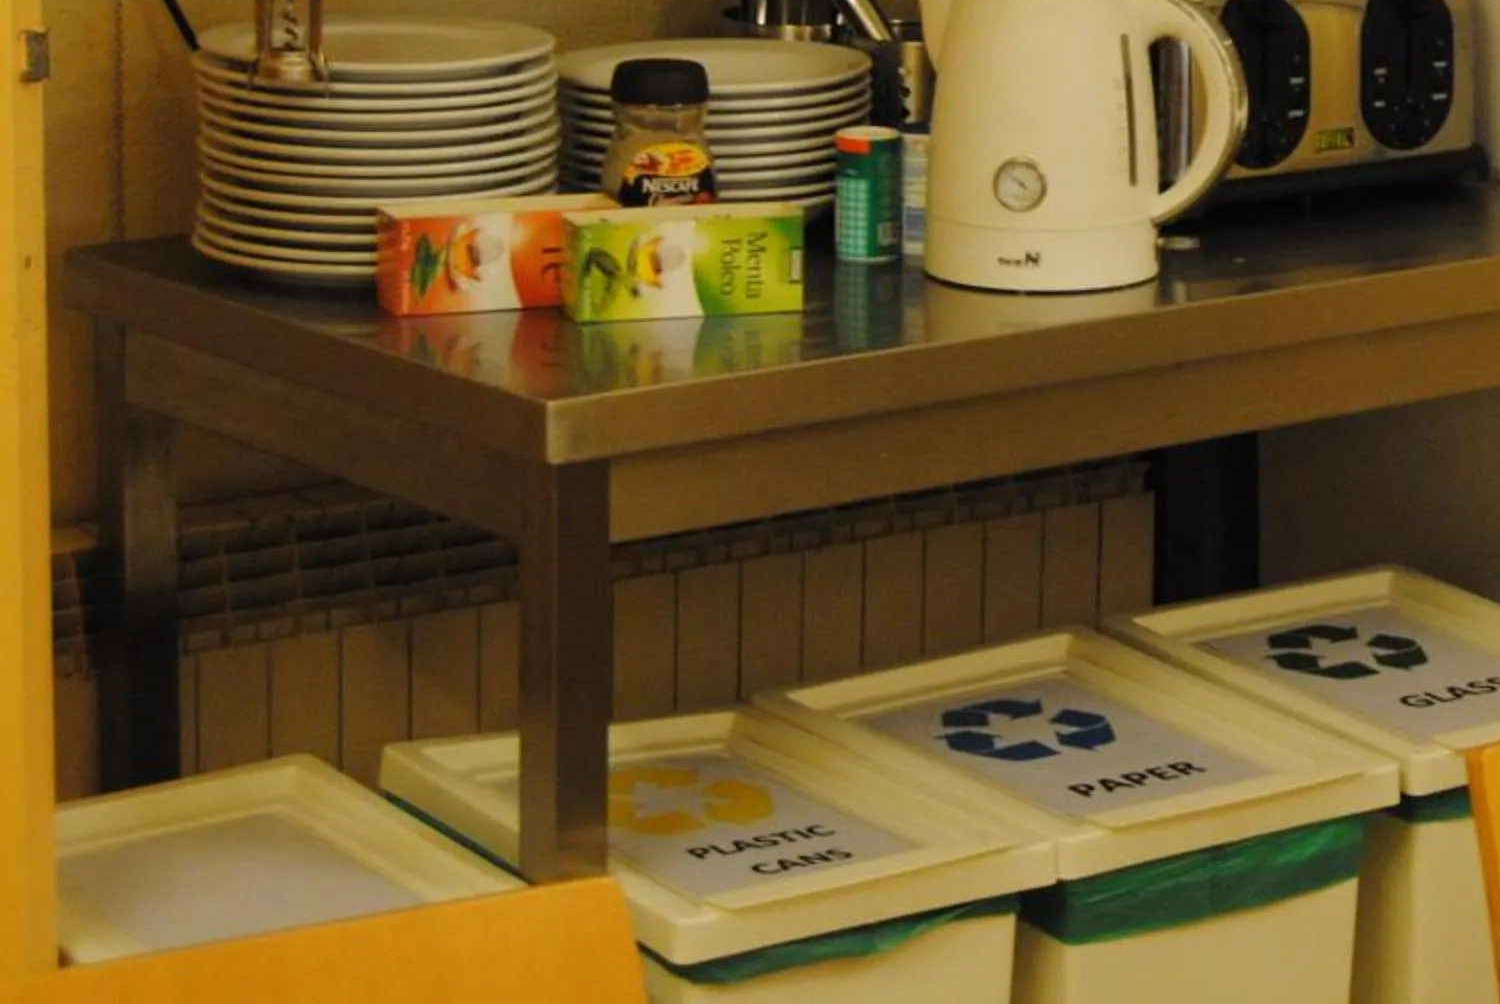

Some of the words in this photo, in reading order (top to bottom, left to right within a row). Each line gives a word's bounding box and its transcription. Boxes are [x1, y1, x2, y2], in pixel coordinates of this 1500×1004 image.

[719, 237, 742, 297] Poleo
[745, 230, 769, 300] Menta
[1067, 761, 1207, 798] PAPER
[686, 824, 836, 860] PLASTIC
[752, 848, 855, 876] CANS
